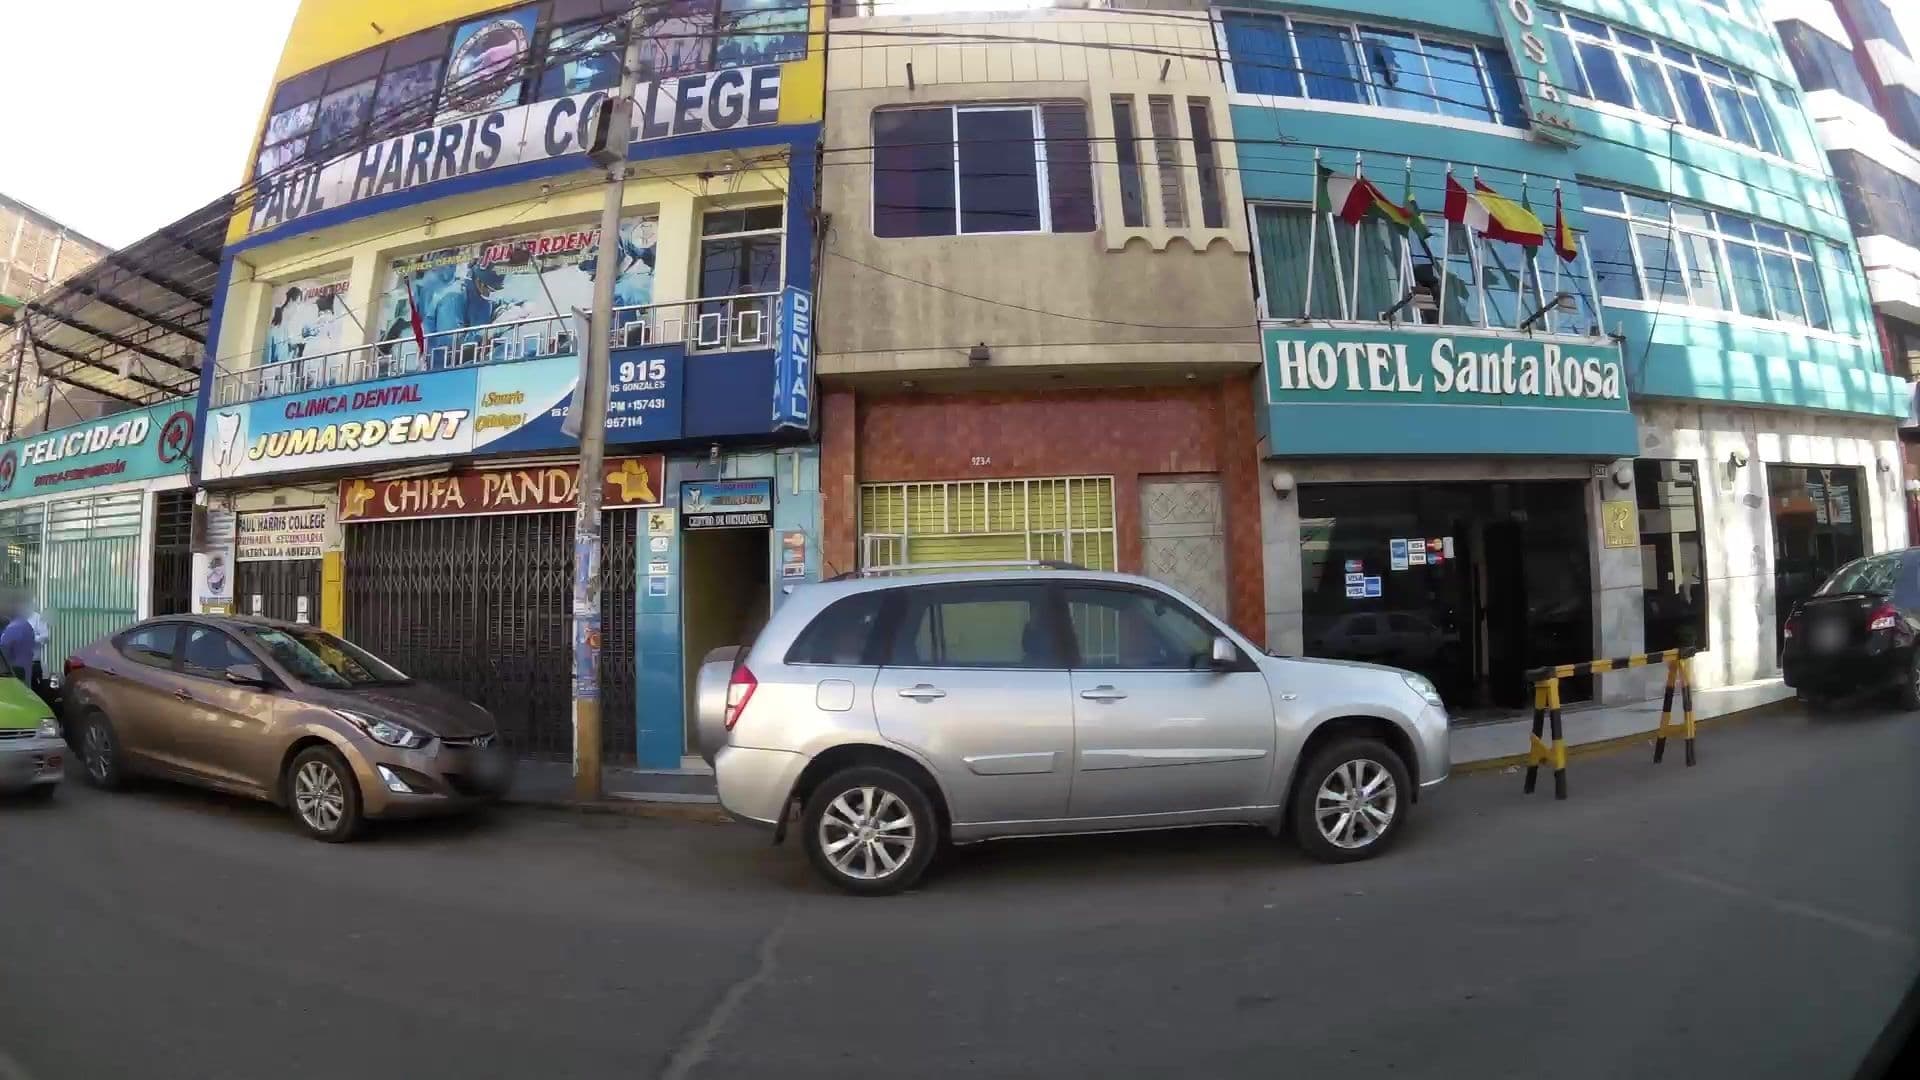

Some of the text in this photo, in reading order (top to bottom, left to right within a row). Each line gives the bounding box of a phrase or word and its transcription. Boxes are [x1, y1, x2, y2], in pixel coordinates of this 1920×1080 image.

[249, 160, 325, 233] PAUL
[351, 111, 505, 199] HARRIS
[545, 65, 780, 157] COLEGE
[619, 359, 666, 383] 915
[792, 293, 809, 420] DENTAL
[1275, 339, 1423, 393] HOTEL
[284, 384, 423, 420] CLINICA DENTAL
[623, 380, 665, 393] GONZALES
[20, 416, 150, 468] FELICIDAD
[248, 409, 470, 461] JUMARDENT
[383, 477, 466, 514] CHIFA
[257, 516, 287, 532] HARRIS
[288, 514, 326, 529] COLLEGE
